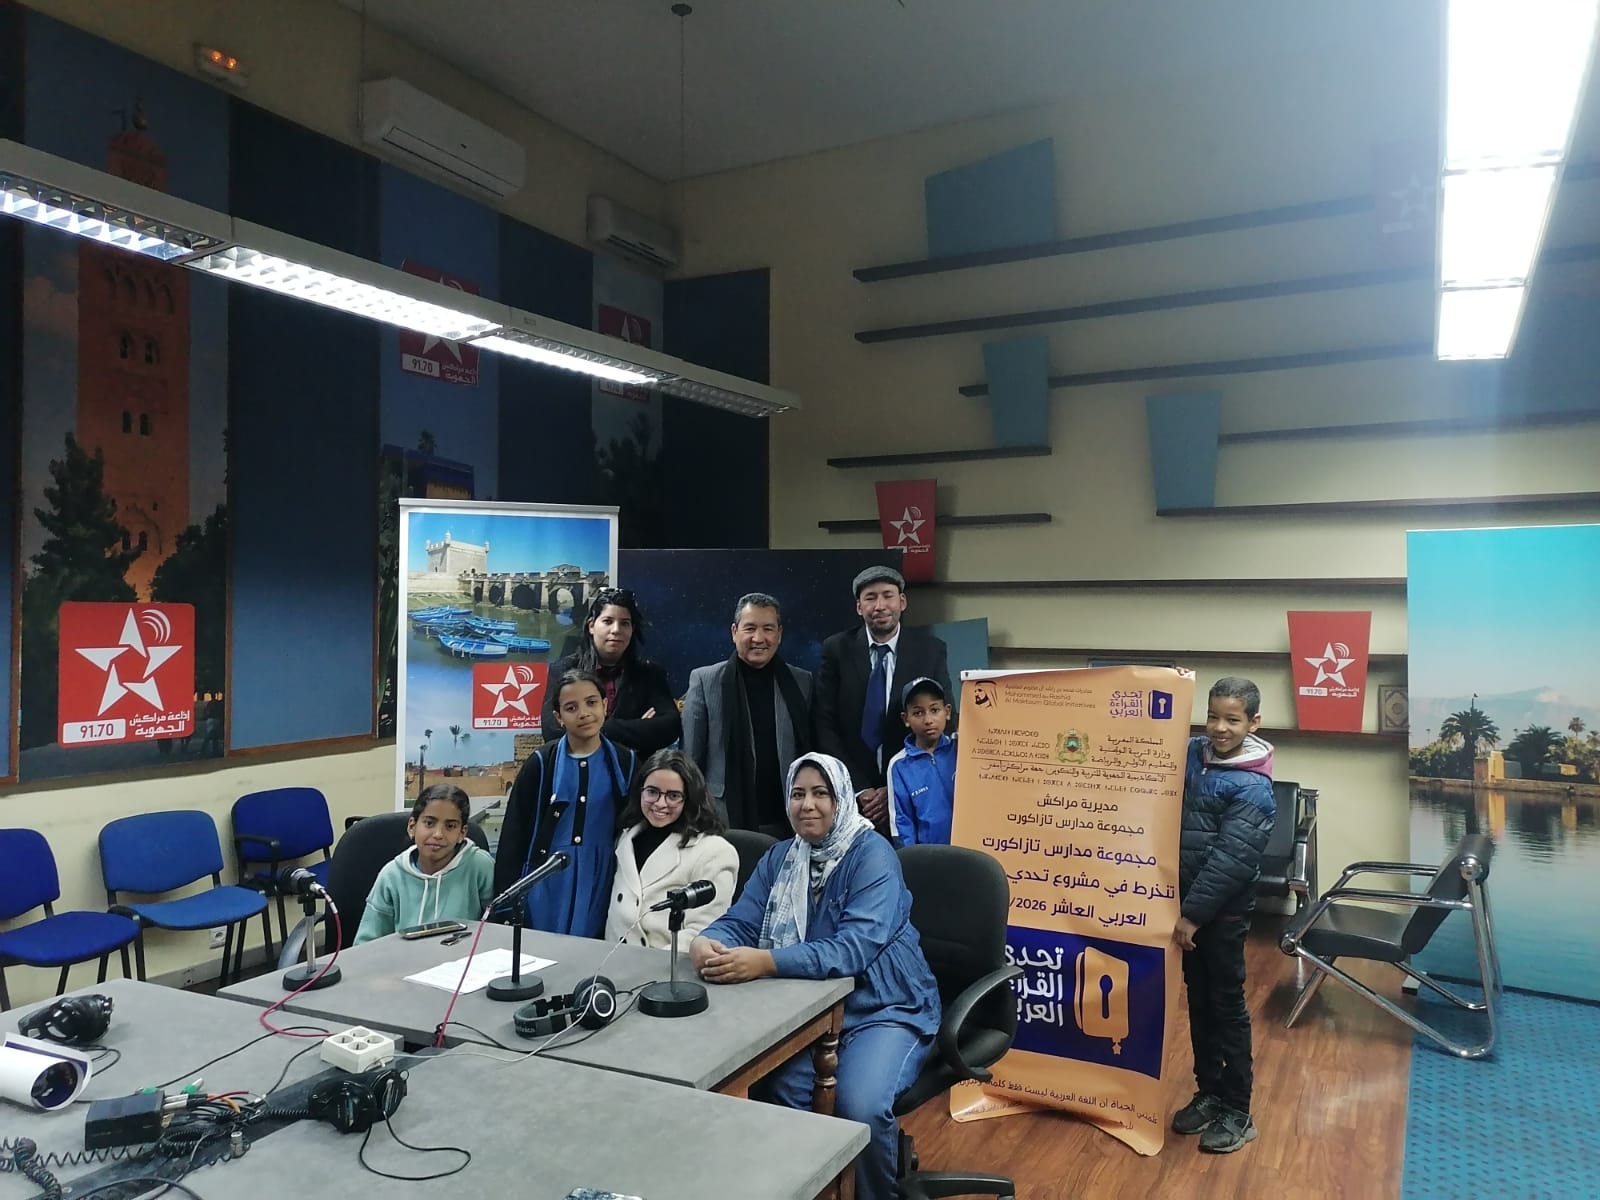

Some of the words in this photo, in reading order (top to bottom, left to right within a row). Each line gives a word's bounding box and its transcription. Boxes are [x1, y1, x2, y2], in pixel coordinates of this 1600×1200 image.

[1109, 698, 1143, 709] القراءة
[129, 711, 166, 727] مراكش
[167, 709, 190, 722] إذاعة
[1110, 708, 1143, 719] العربي
[80, 723, 114, 739] 91.70
[135, 720, 185, 738] الجهوية
[1107, 734, 1134, 746] المغربية
[1135, 737, 1164, 746] المملكة
[1099, 745, 1127, 756] الوطنية
[1128, 747, 1150, 759] التربية
[1153, 749, 1171, 760] وزارة
[1091, 756, 1121, 767] والرياضة
[1148, 760, 1177, 771] والتعليم
[1045, 767, 1080, 777] والتكوين
[1081, 768, 1101, 779] للتربية
[1037, 795, 1078, 810] مراكش
[1080, 798, 1118, 814] مديرية
[1007, 812, 1053, 826] تازاكورت
[1055, 816, 1094, 830] مدارس
[1097, 820, 1145, 837] مجموعة
[982, 836, 1040, 855] تازاكورت
[1044, 843, 1092, 859] مدارس
[1096, 846, 1157, 868] مجموعة
[1006, 868, 1049, 885] تحدي
[1052, 871, 1100, 889] مشروع
[1103, 880, 1128, 899] في
[1133, 881, 1175, 900] تنخرط
[1051, 898, 1094, 918] العاشر
[1098, 908, 1146, 928] العربي
[1017, 998, 1063, 1027] العرب
[990, 1079, 1006, 1089] كلما
[1007, 1081, 1023, 1092] فقط
[1024, 1085, 1048, 1097] ليست
[1049, 1091, 1076, 1103] العربية
[1078, 1094, 1097, 1106] اللغة
[1110, 1101, 1136, 1113] الحياة
